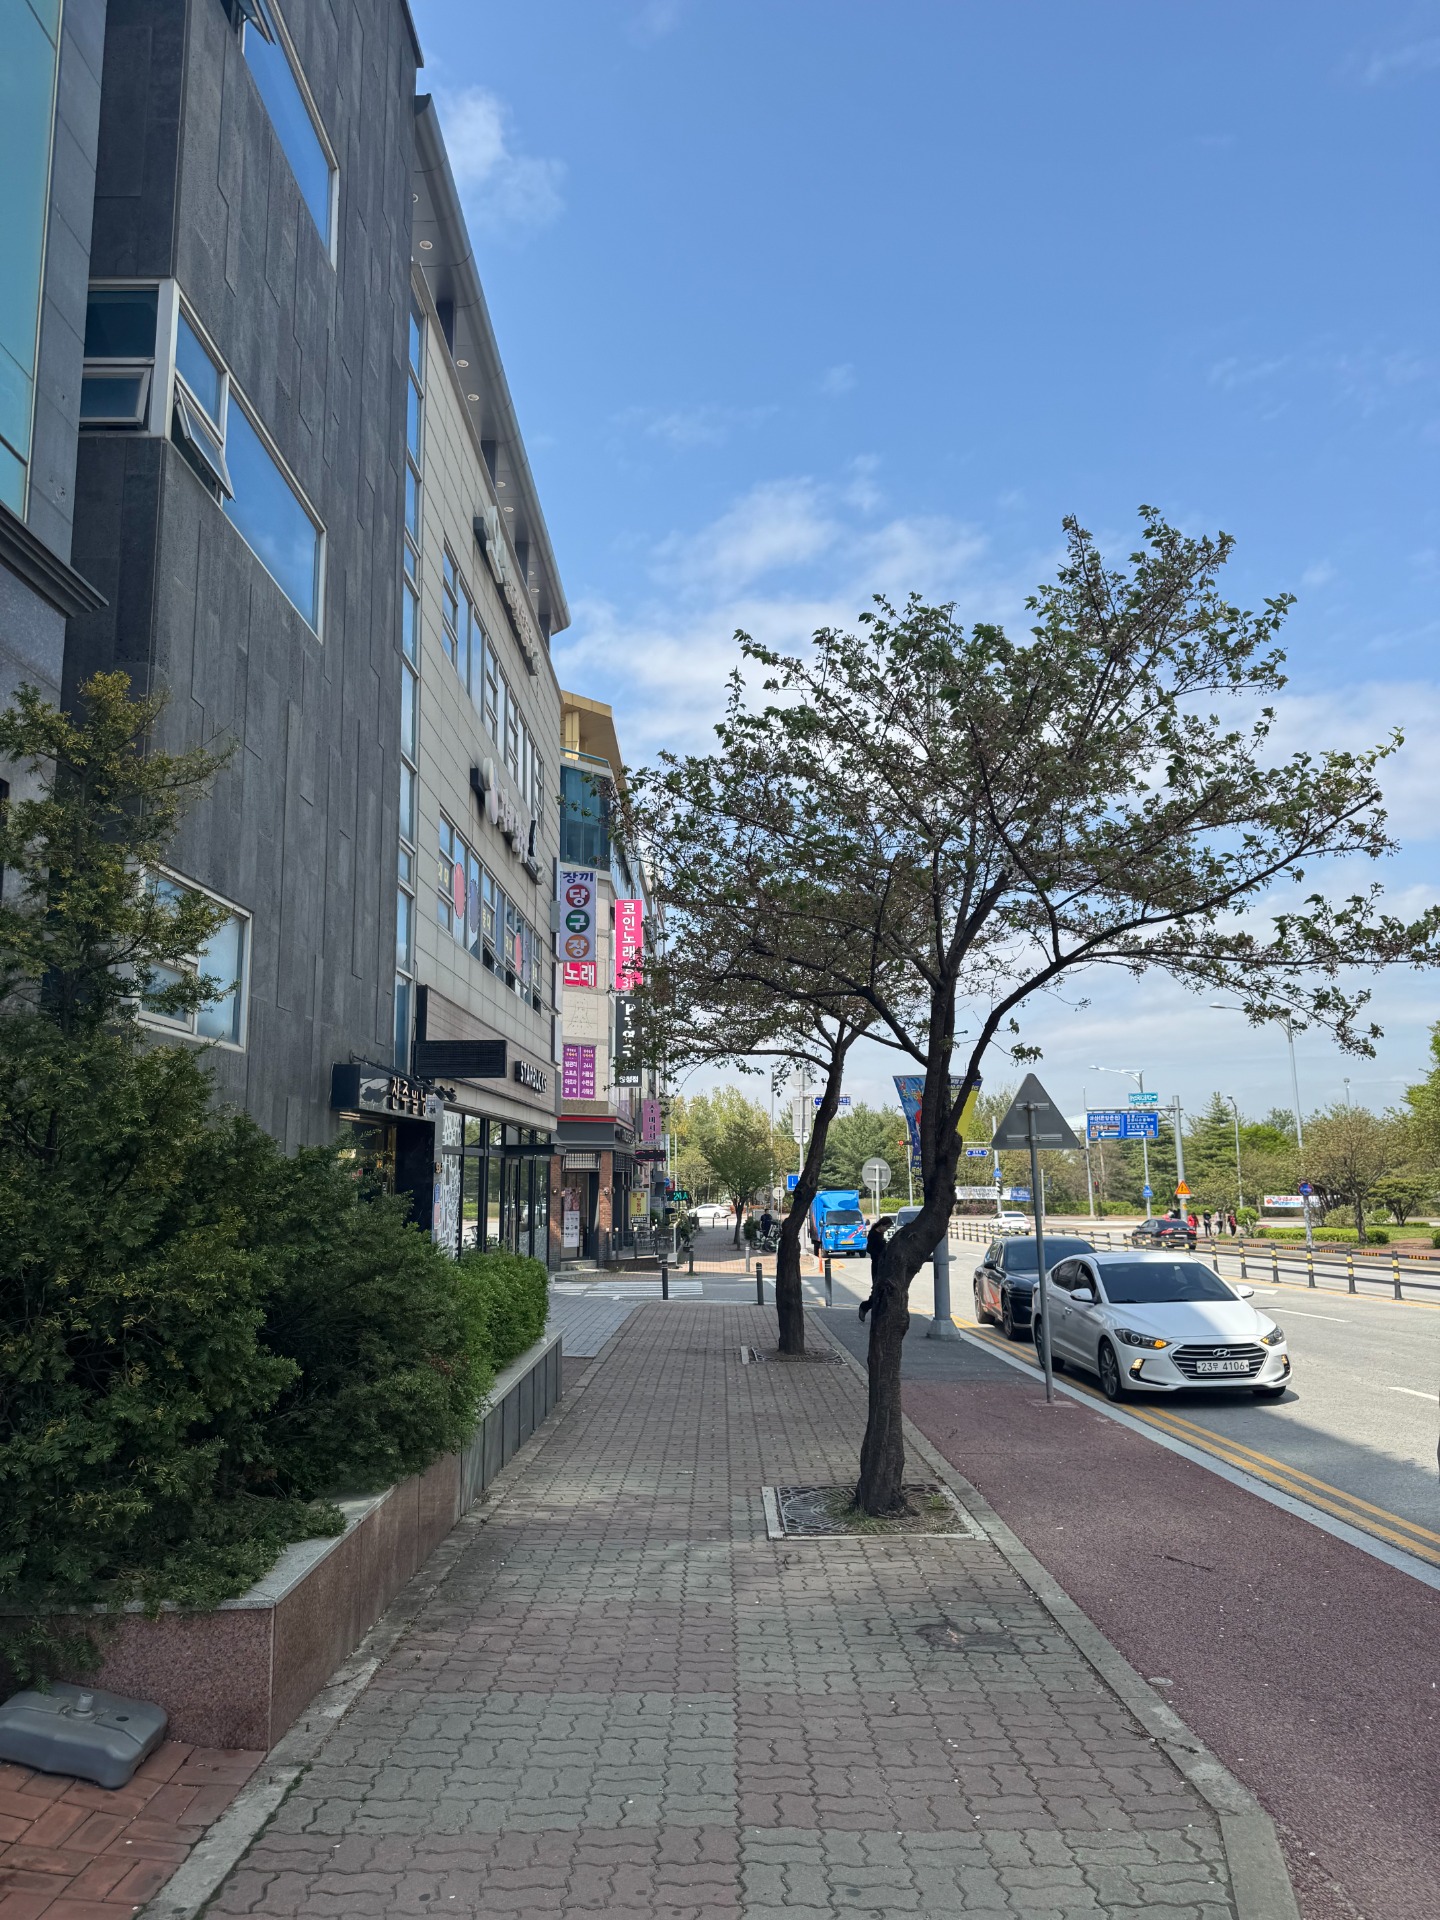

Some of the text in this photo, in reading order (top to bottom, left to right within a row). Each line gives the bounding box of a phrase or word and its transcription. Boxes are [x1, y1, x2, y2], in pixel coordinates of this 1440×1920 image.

[563, 872, 594, 883] 장끼
[568, 888, 589, 957] 당구장
[564, 962, 595, 986] 노래
[520, 1060, 547, 1092] STARBUCKS
[1201, 1361, 1245, 1372] 23무 4106
